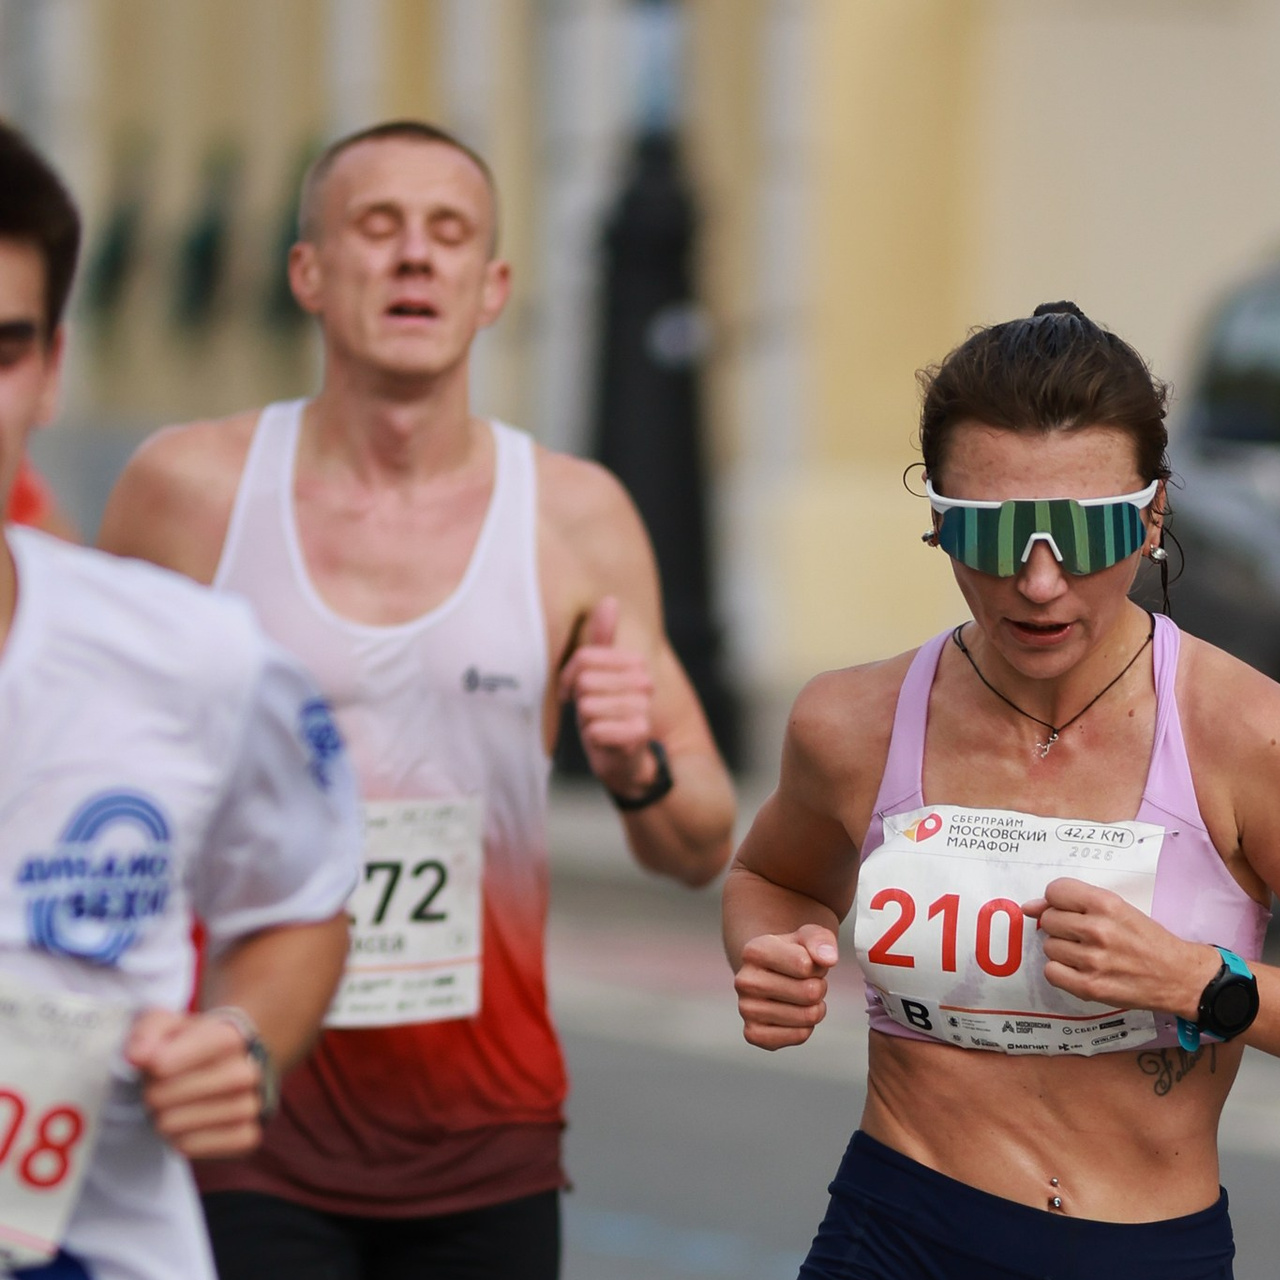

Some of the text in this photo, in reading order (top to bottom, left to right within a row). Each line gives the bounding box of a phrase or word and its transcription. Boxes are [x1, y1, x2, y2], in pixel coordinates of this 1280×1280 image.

[951, 814, 1024, 828] СБЕРПРАЙМ
[949, 824, 1047, 842] МОСКОВСКИЙ
[1064, 827, 1096, 841] 42,2
[947, 837, 1020, 853] МАРАФОН
[1068, 846, 1114, 862] 2026
[350, 860, 449, 925] 72
[868, 888, 1041, 977] 210
